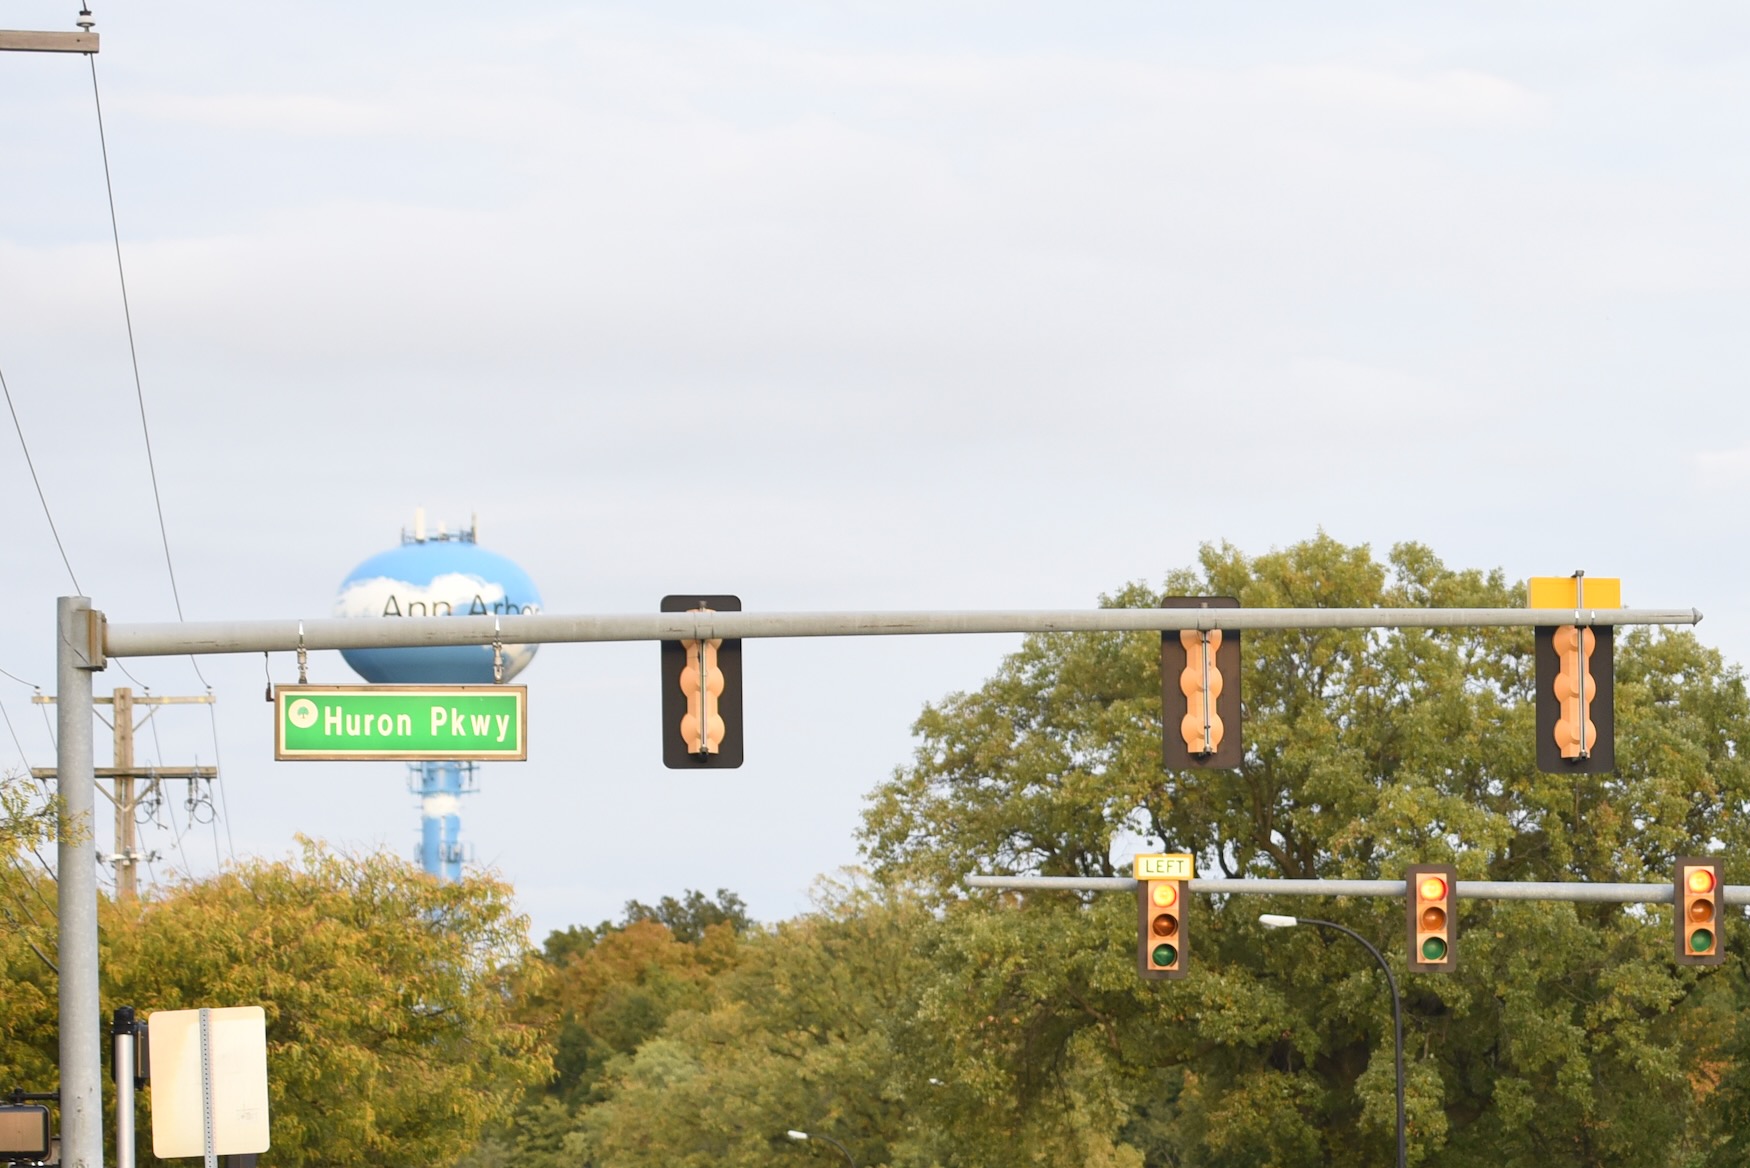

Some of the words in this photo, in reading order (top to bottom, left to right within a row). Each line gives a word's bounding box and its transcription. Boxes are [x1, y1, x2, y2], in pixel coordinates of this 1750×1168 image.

[382, 594, 451, 617] Ann
[324, 705, 412, 736] Huron
[430, 706, 510, 743] Pkwy
[1146, 860, 1184, 873] LEFT
